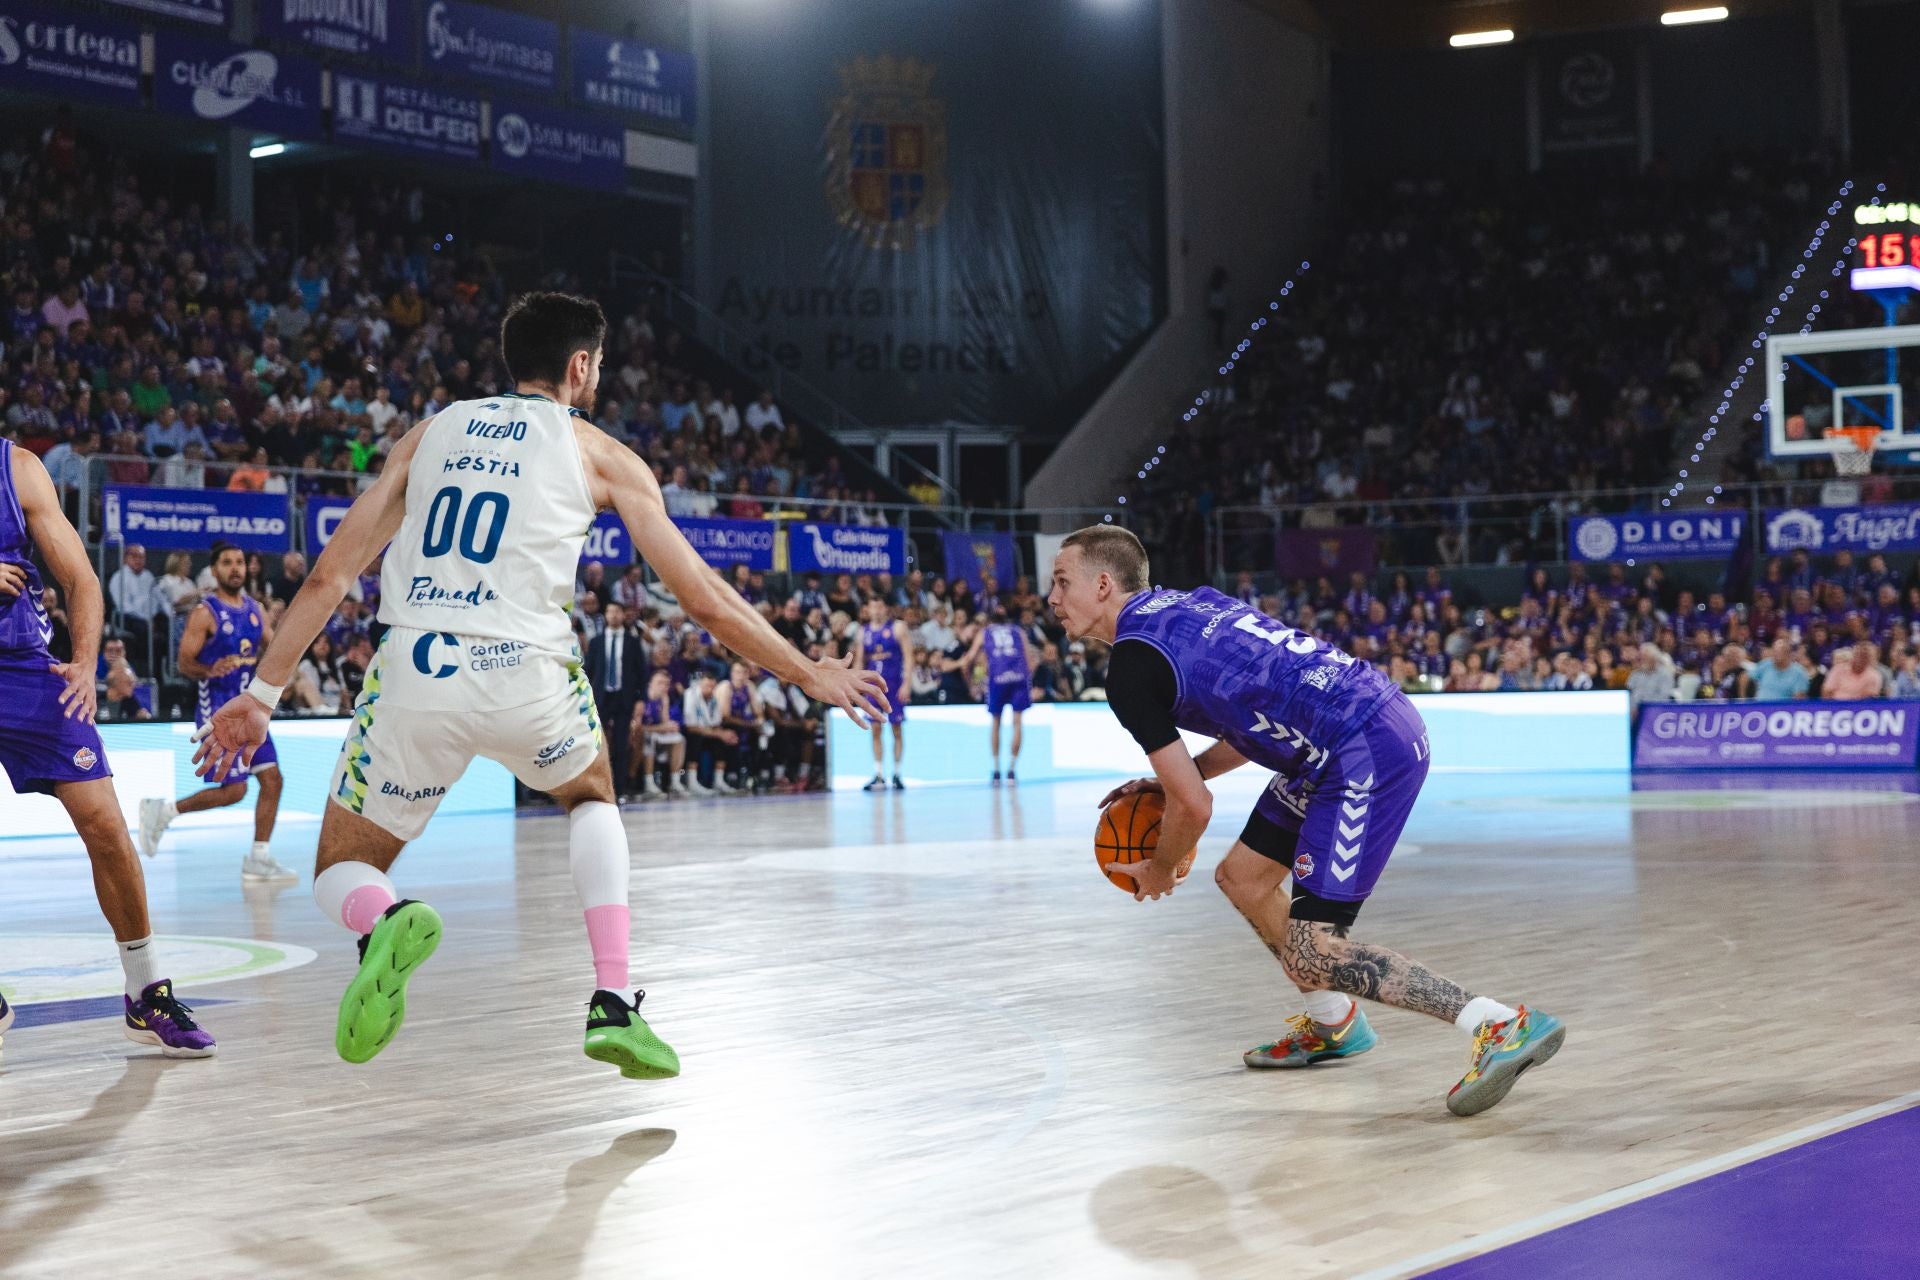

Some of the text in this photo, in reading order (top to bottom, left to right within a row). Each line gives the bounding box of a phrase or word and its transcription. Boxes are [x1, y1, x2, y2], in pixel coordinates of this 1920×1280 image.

[385, 105, 479, 145] DELFER
[466, 418, 527, 441] VICEDO
[206, 516, 285, 535] SUAZO
[423, 486, 510, 564] 00
[1622, 518, 1740, 543] DIONI
[407, 576, 500, 606] Pomada
[471, 654, 522, 672] center
